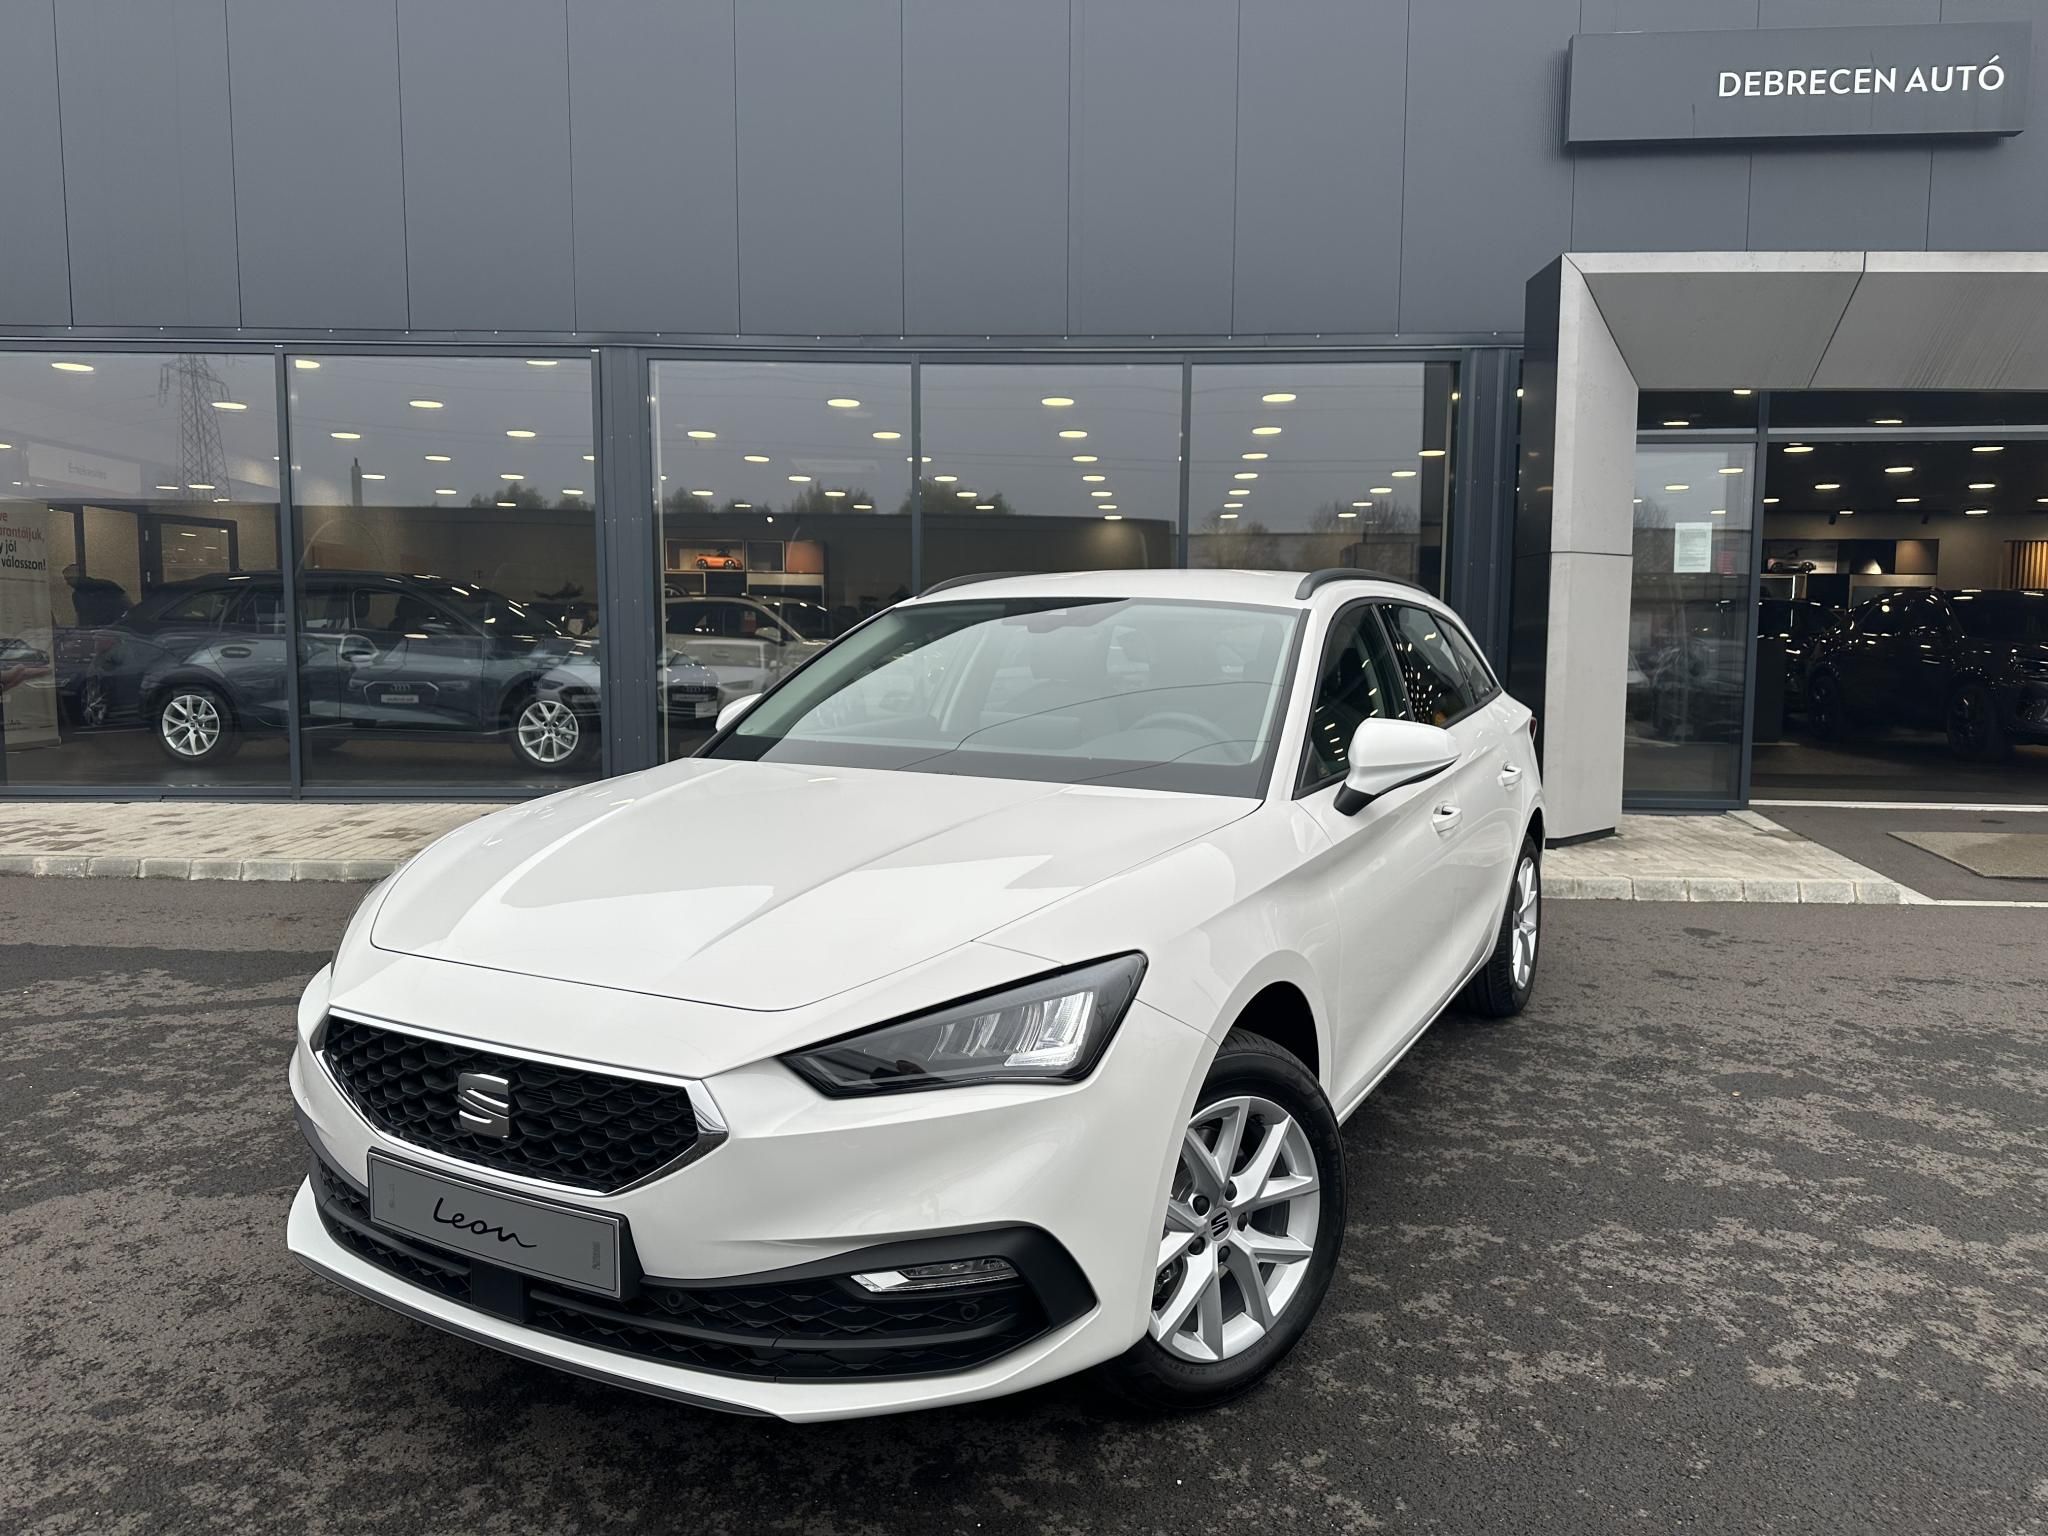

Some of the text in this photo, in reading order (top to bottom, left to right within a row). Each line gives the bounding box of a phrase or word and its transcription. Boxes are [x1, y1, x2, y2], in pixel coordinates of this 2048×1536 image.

[1718, 54, 2005, 97] DEBRECEN AUTÓ
[5, 539, 17, 555] jól
[1, 555, 46, 571] válasszon!
[433, 1197, 537, 1248] Leon
